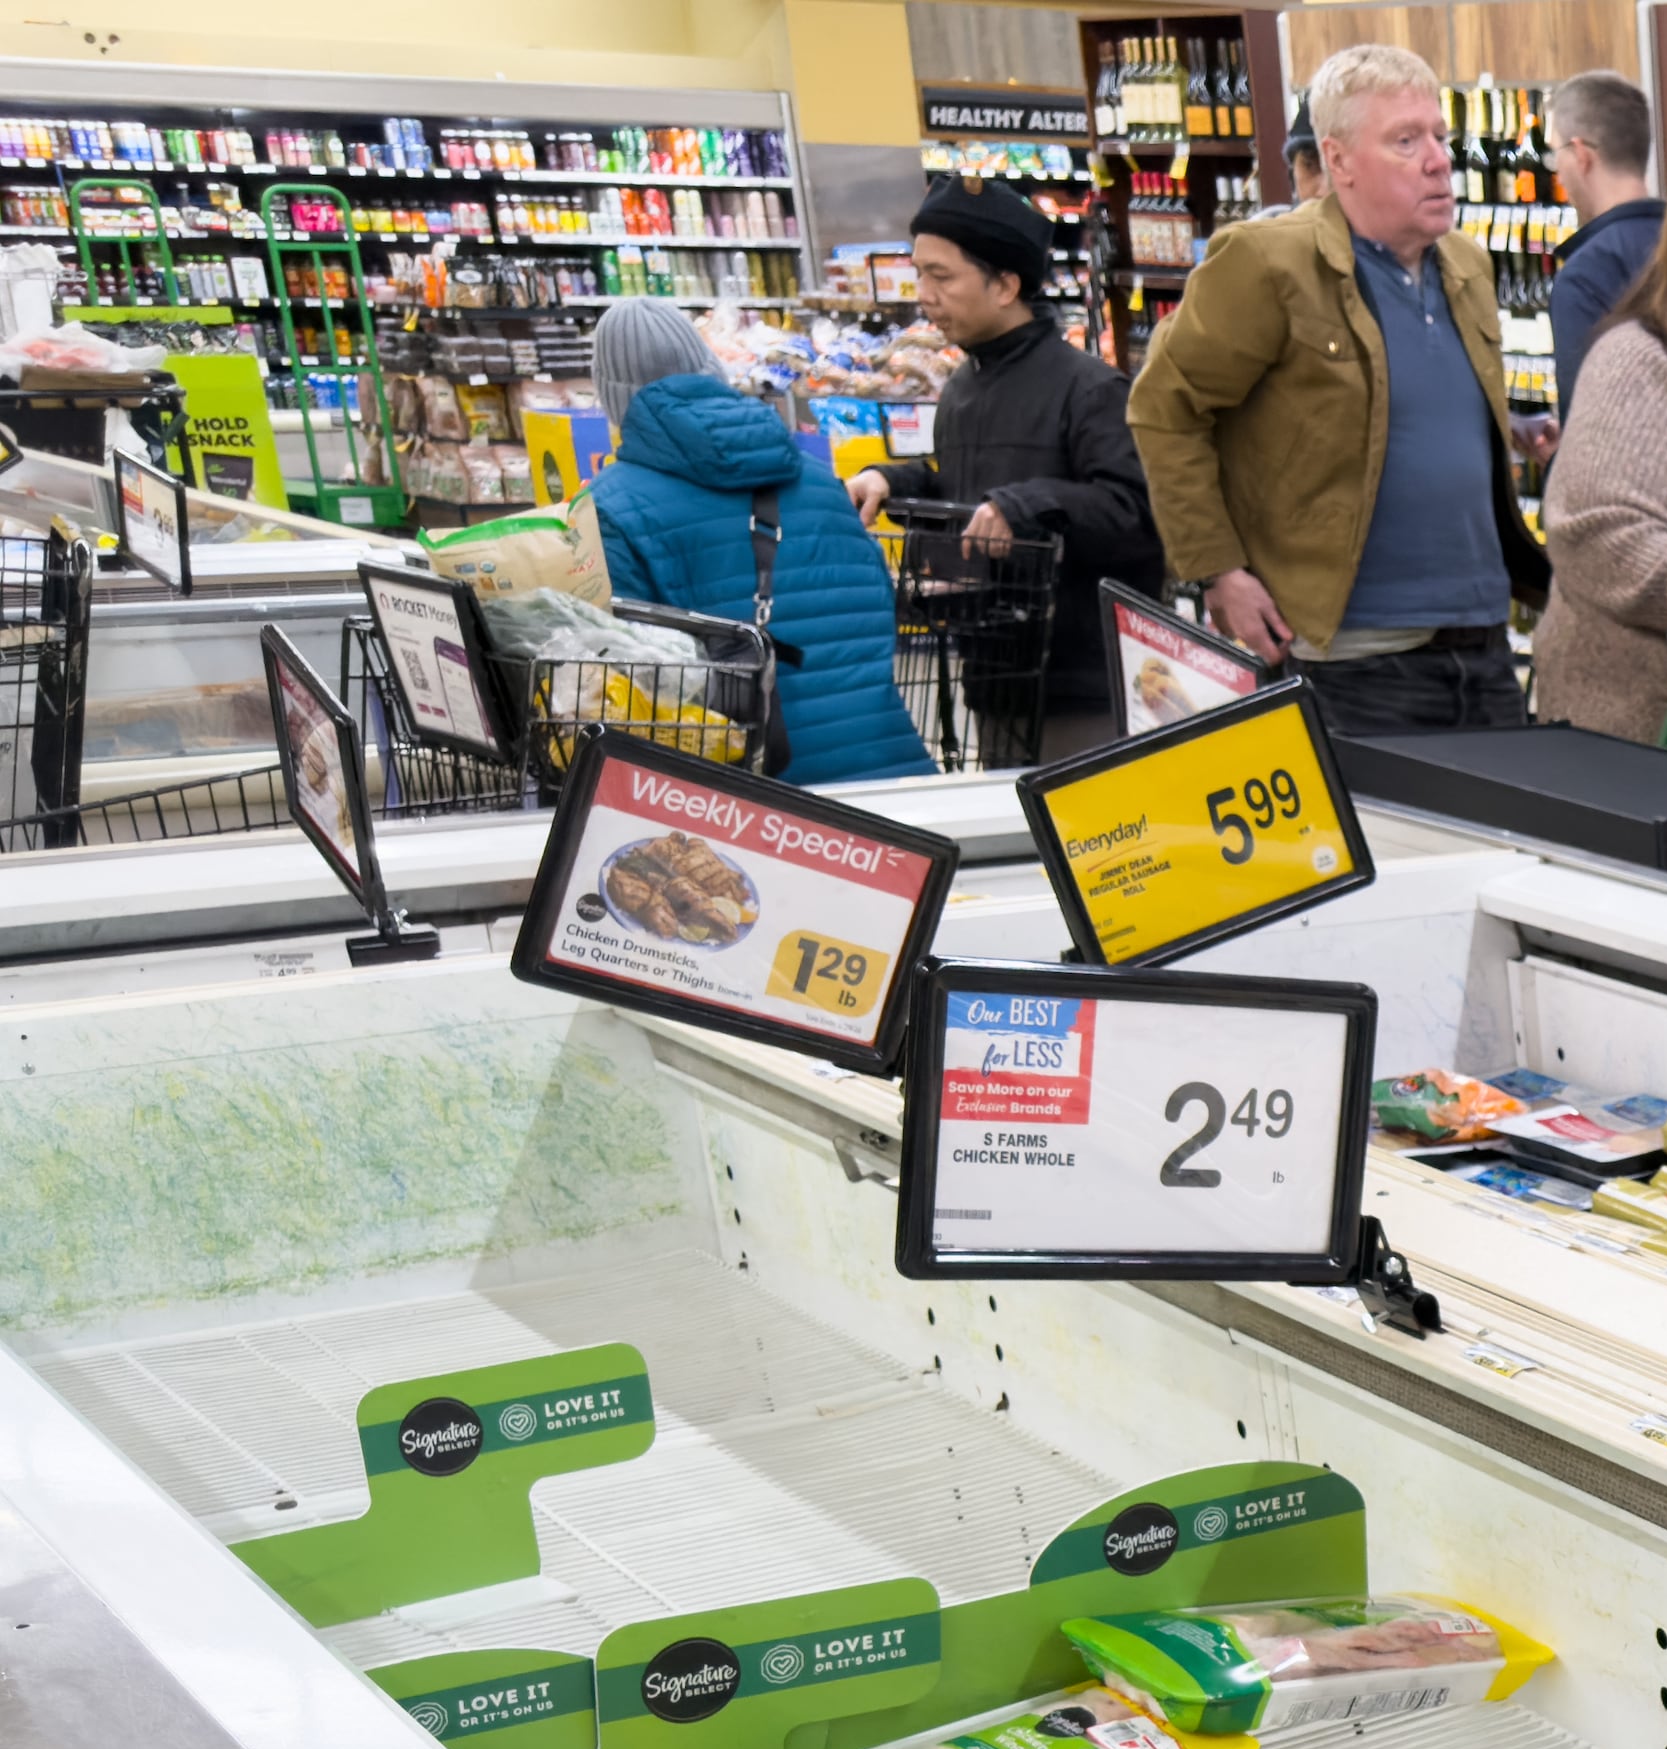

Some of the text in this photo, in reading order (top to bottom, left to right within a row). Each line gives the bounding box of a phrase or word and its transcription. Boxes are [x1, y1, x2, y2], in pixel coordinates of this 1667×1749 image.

[930, 106, 1024, 128] HEALTHY
[194, 417, 248, 430] HOLD
[391, 597, 428, 618] ROCKET
[1125, 611, 1180, 658] Weekly
[632, 771, 882, 875] Weekly Special
[1066, 813, 1149, 860] Everyday!
[1129, 855, 1153, 871] DEAN
[566, 924, 700, 971] Chicken Drumsticks,
[560, 938, 715, 992] Leg Quarters or Thighs
[838, 992, 857, 1007] lb
[967, 998, 1062, 1028] Our BEST
[982, 1040, 1063, 1077] for LESS
[948, 1080, 1072, 1099] Save More on our
[956, 1096, 1062, 1117] Exclusive Brands
[984, 1133, 1048, 1148] S FARMS
[952, 1149, 1075, 1167] CHICKEN WHOLE
[1272, 1170, 1285, 1185] lb
[544, 1390, 622, 1418] LOVE IT
[546, 1408, 624, 1431] OR IT'S ON US
[402, 1421, 480, 1458] Signature
[437, 1438, 477, 1453] SELECT
[1235, 1492, 1306, 1518] LOVE IT
[1236, 1508, 1307, 1530] OR IT'S ON US
[1106, 1524, 1176, 1559] Signature
[1136, 1539, 1173, 1554] SELECT
[814, 1628, 907, 1660] LOVE IT
[814, 1648, 907, 1674] OR IT'S ON US
[646, 1665, 737, 1703] Signature
[685, 1682, 733, 1698] SELECT
